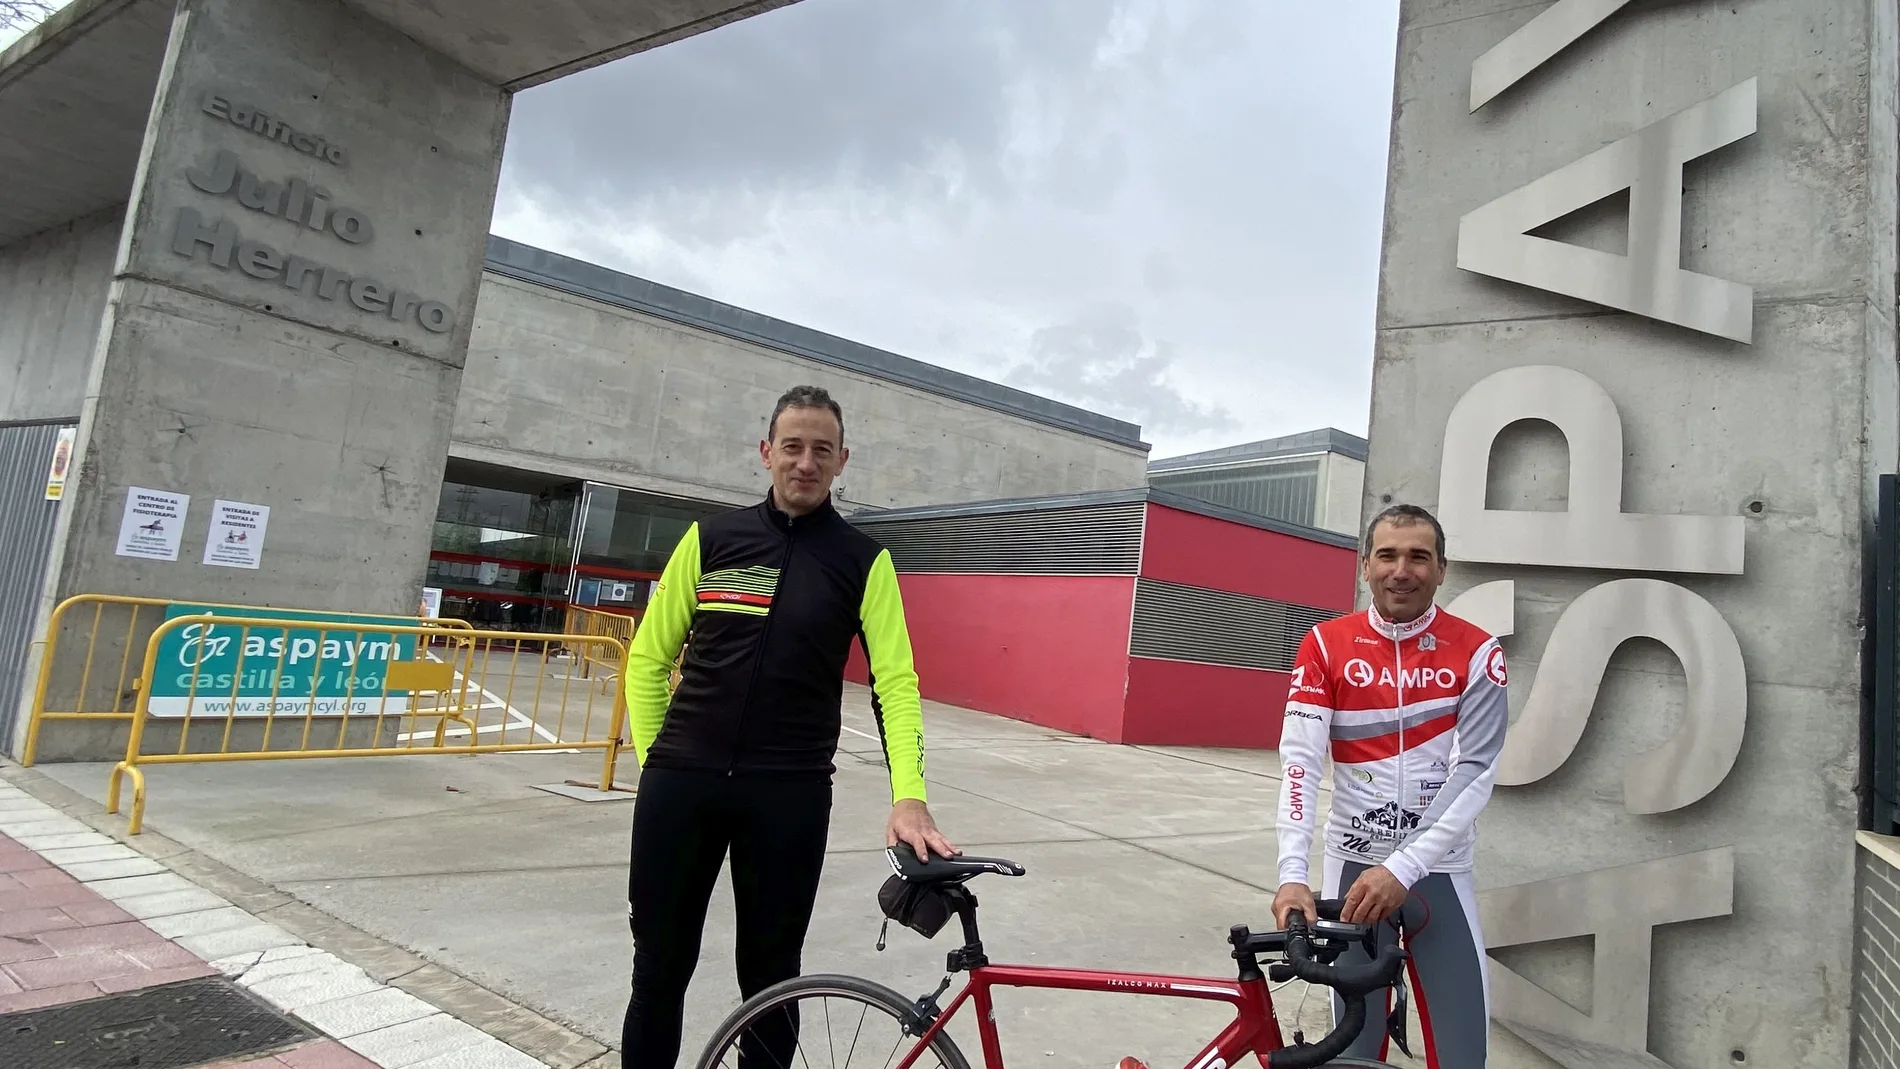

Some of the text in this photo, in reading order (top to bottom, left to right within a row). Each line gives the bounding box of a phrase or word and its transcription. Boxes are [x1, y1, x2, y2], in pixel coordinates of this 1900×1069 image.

[202, 95, 345, 165] Edificio
[186, 151, 374, 244] Julio
[172, 207, 455, 333] Herrero
[137, 495, 169, 504] ENTRADA
[138, 502, 166, 510] CENTRO
[133, 508, 178, 519] FISIOTERAPIA
[222, 507, 251, 515] ENTRADA
[221, 520, 256, 529] RESIDENTES
[226, 514, 249, 522] VISITAS
[244, 635, 401, 666] aspaym
[176, 668, 295, 690] castilla
[305, 674, 322, 694] y
[1378, 666, 1457, 689] AMPO
[1285, 709, 1323, 722] ORBEA
[1289, 781, 1304, 821] AMPO
[1107, 979, 1167, 989] IZALCO MAX
